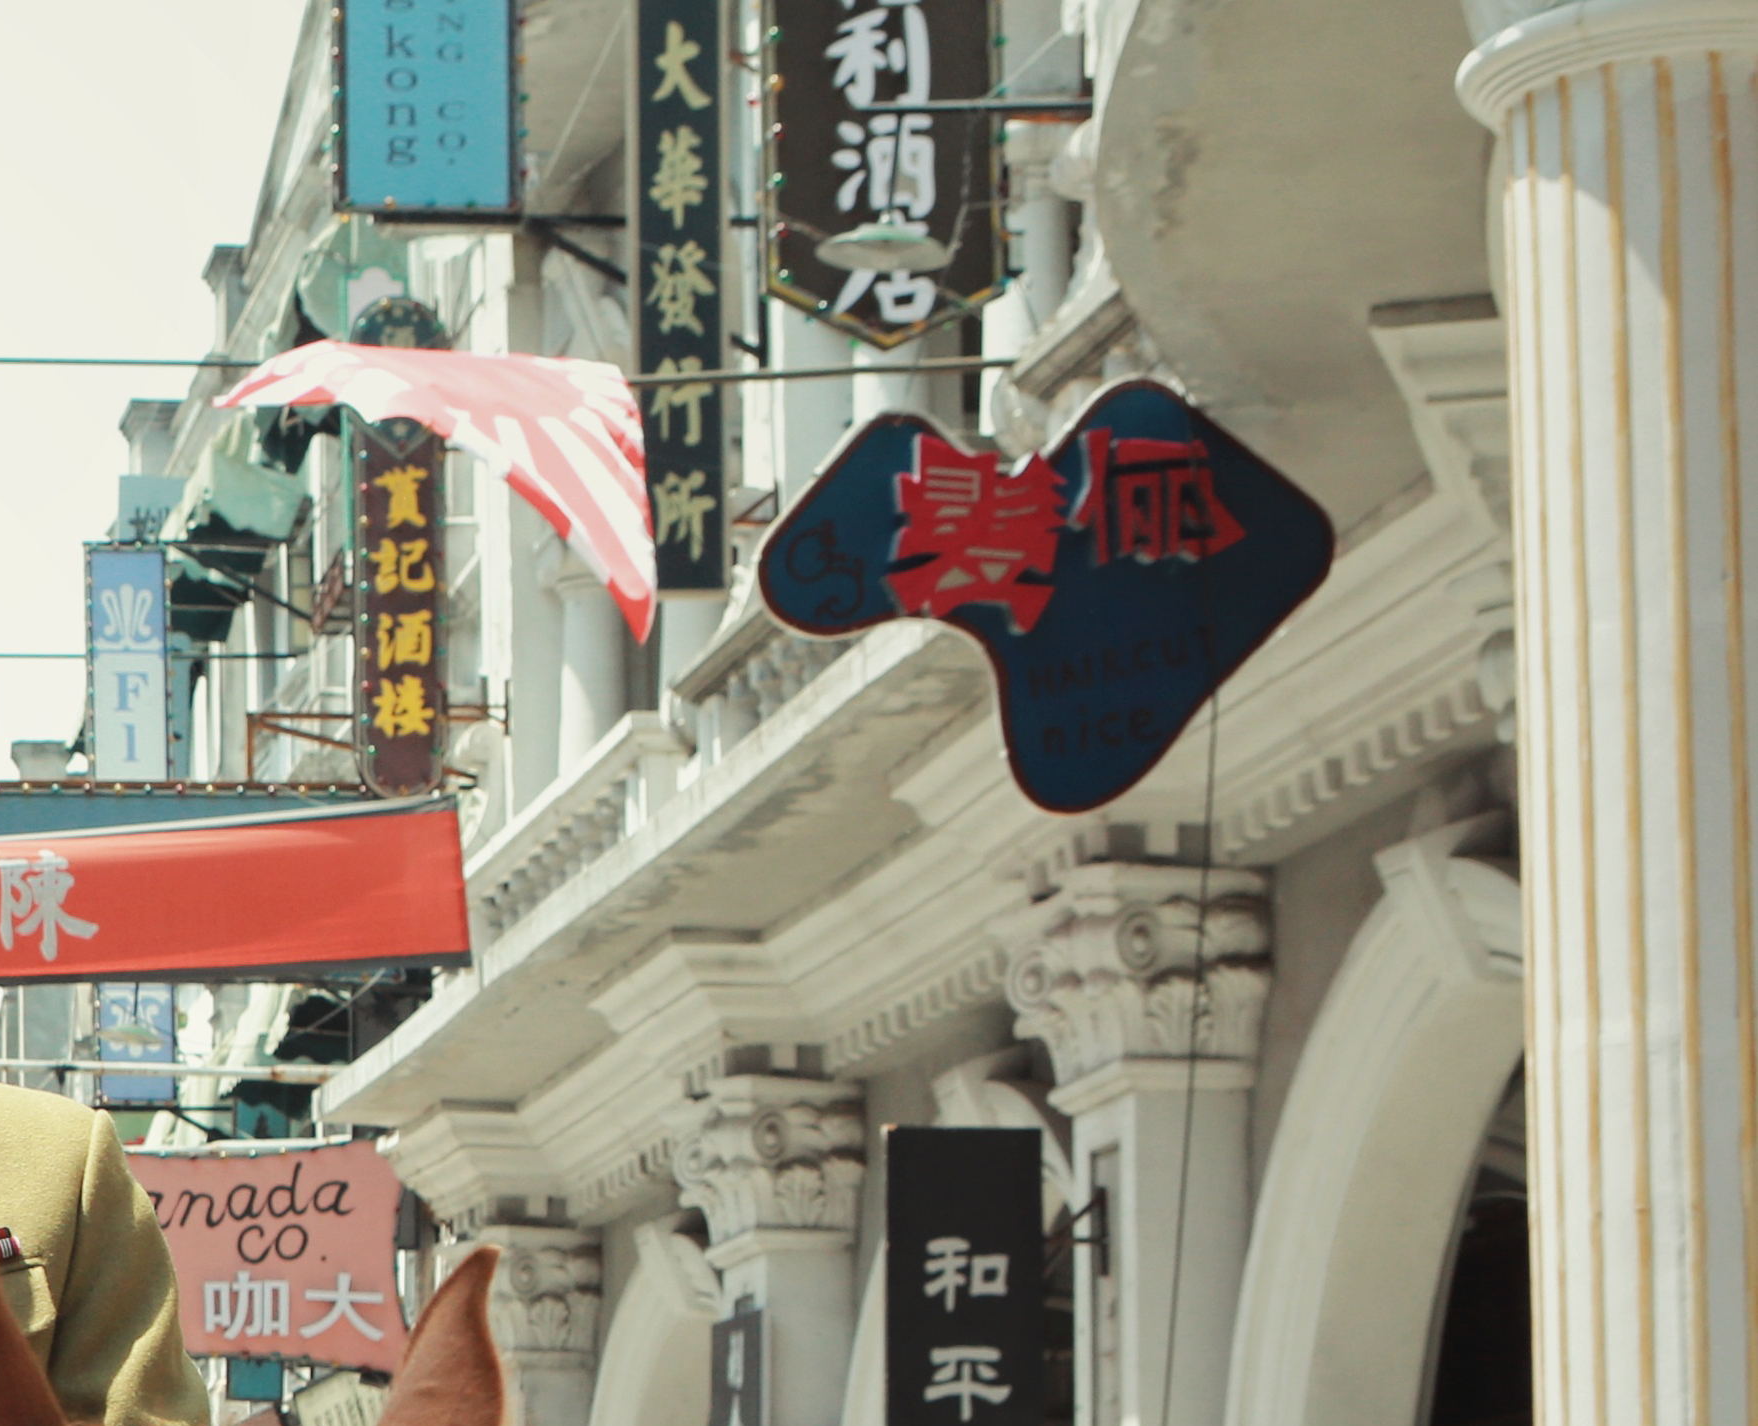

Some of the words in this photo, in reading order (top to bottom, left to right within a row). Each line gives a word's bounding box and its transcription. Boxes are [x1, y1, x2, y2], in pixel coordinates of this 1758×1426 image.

[385, 0, 418, 166] kong
[825, 0, 937, 323] 利酒店
[649, 20, 716, 562] 大華發行所
[1027, 625, 1215, 700] HAIRCUT
[146, 1161, 356, 1230] anada
